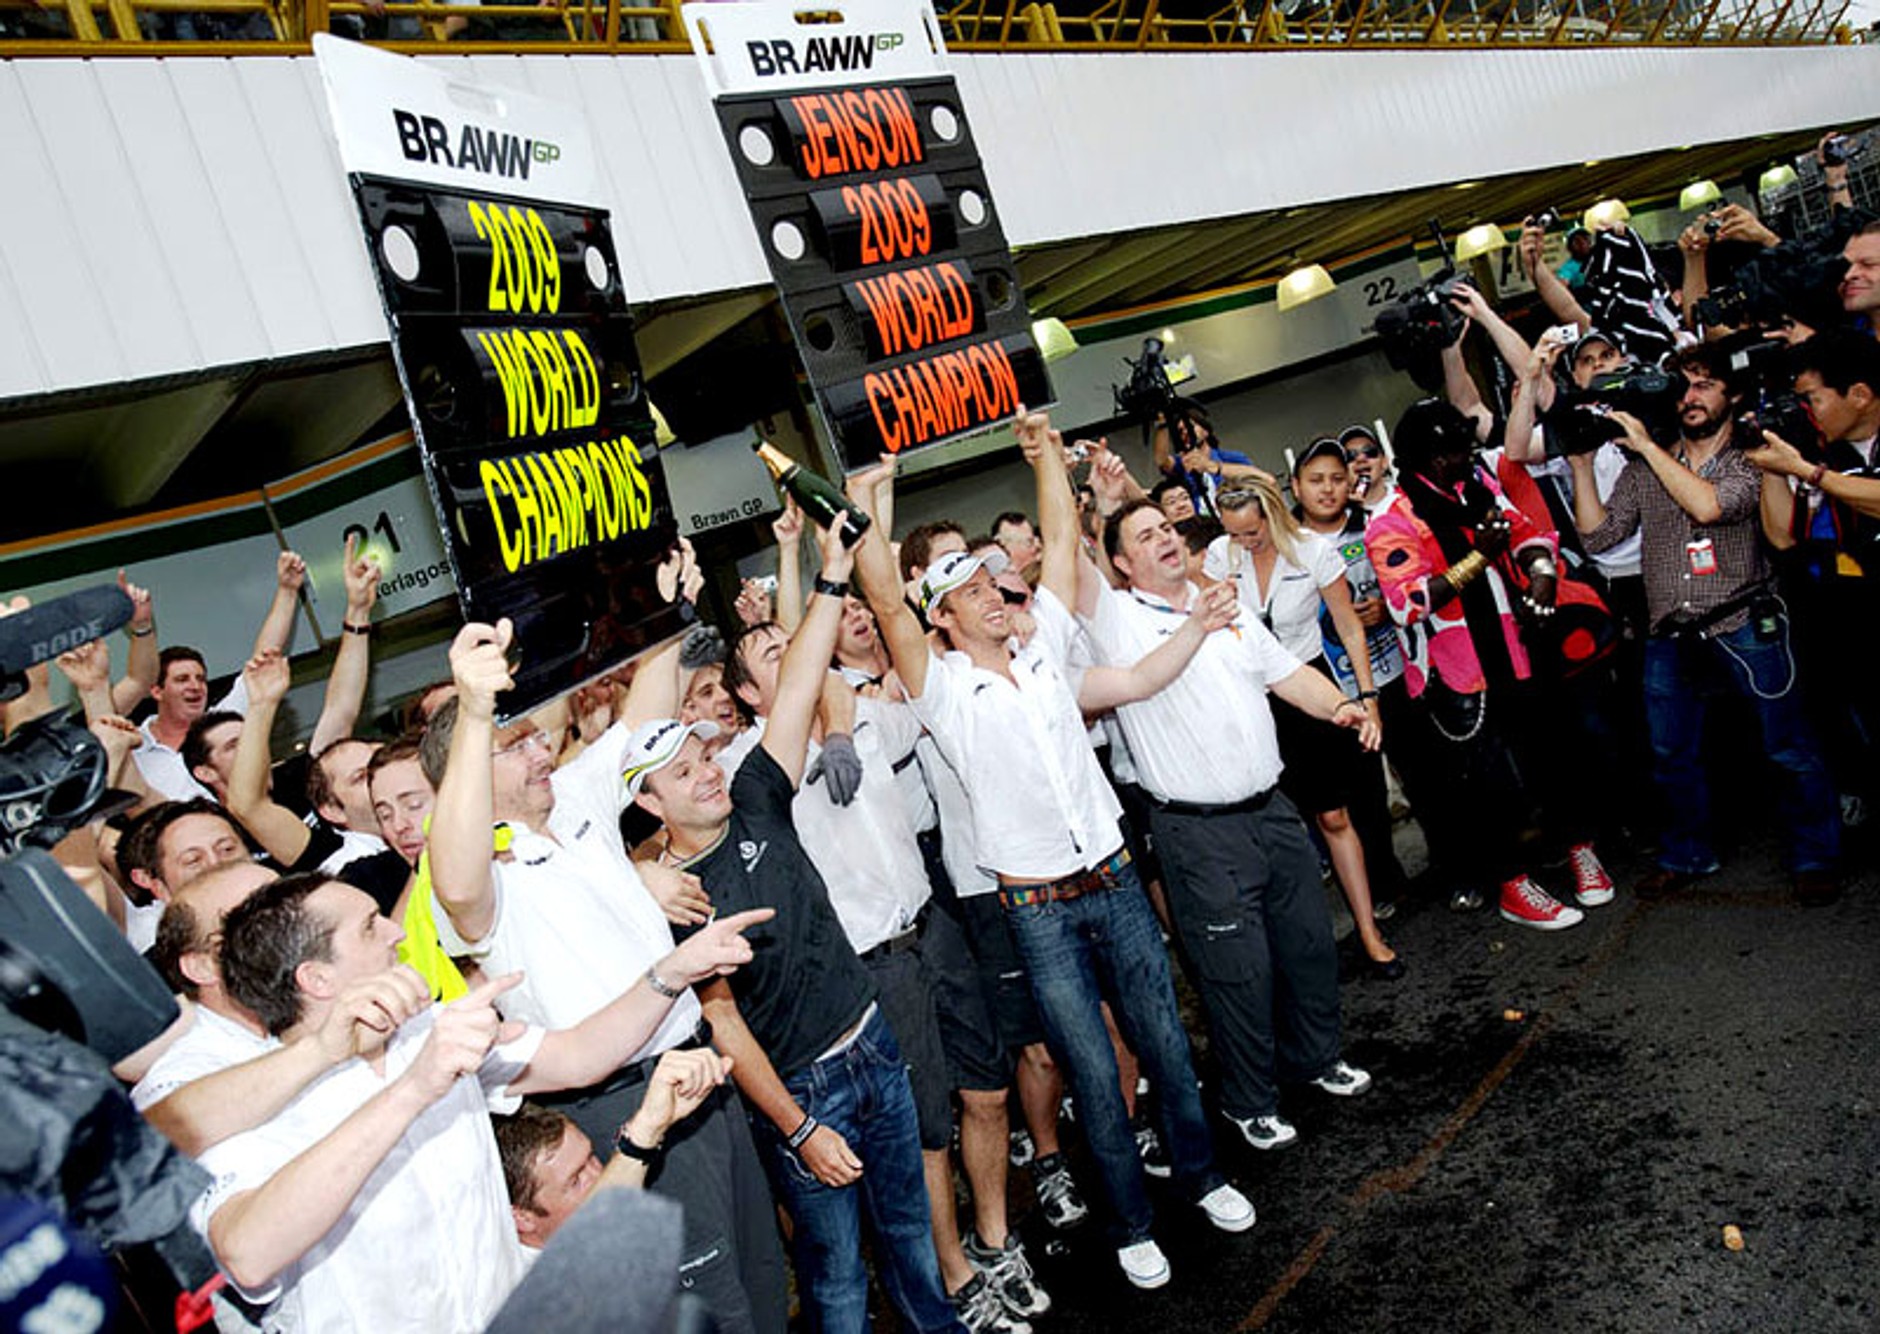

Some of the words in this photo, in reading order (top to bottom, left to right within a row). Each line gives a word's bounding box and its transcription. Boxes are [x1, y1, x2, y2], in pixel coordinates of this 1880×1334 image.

[746, 35, 875, 76] BRAWN
[876, 33, 904, 51] GP
[393, 108, 532, 181] BRAWN
[533, 140, 560, 164] GP
[790, 87, 923, 180] JENSON
[468, 201, 561, 314] 2009
[841, 178, 932, 265] 2009
[855, 262, 975, 356] WORLD
[1363, 276, 1399, 307] 22
[478, 328, 600, 438] WORLD
[863, 340, 1020, 453] CHAMPION
[479, 434, 653, 573] CHAMPIONS
[690, 506, 740, 530] Brawn
[741, 497, 763, 516] GP
[375, 560, 452, 600] erlagos
